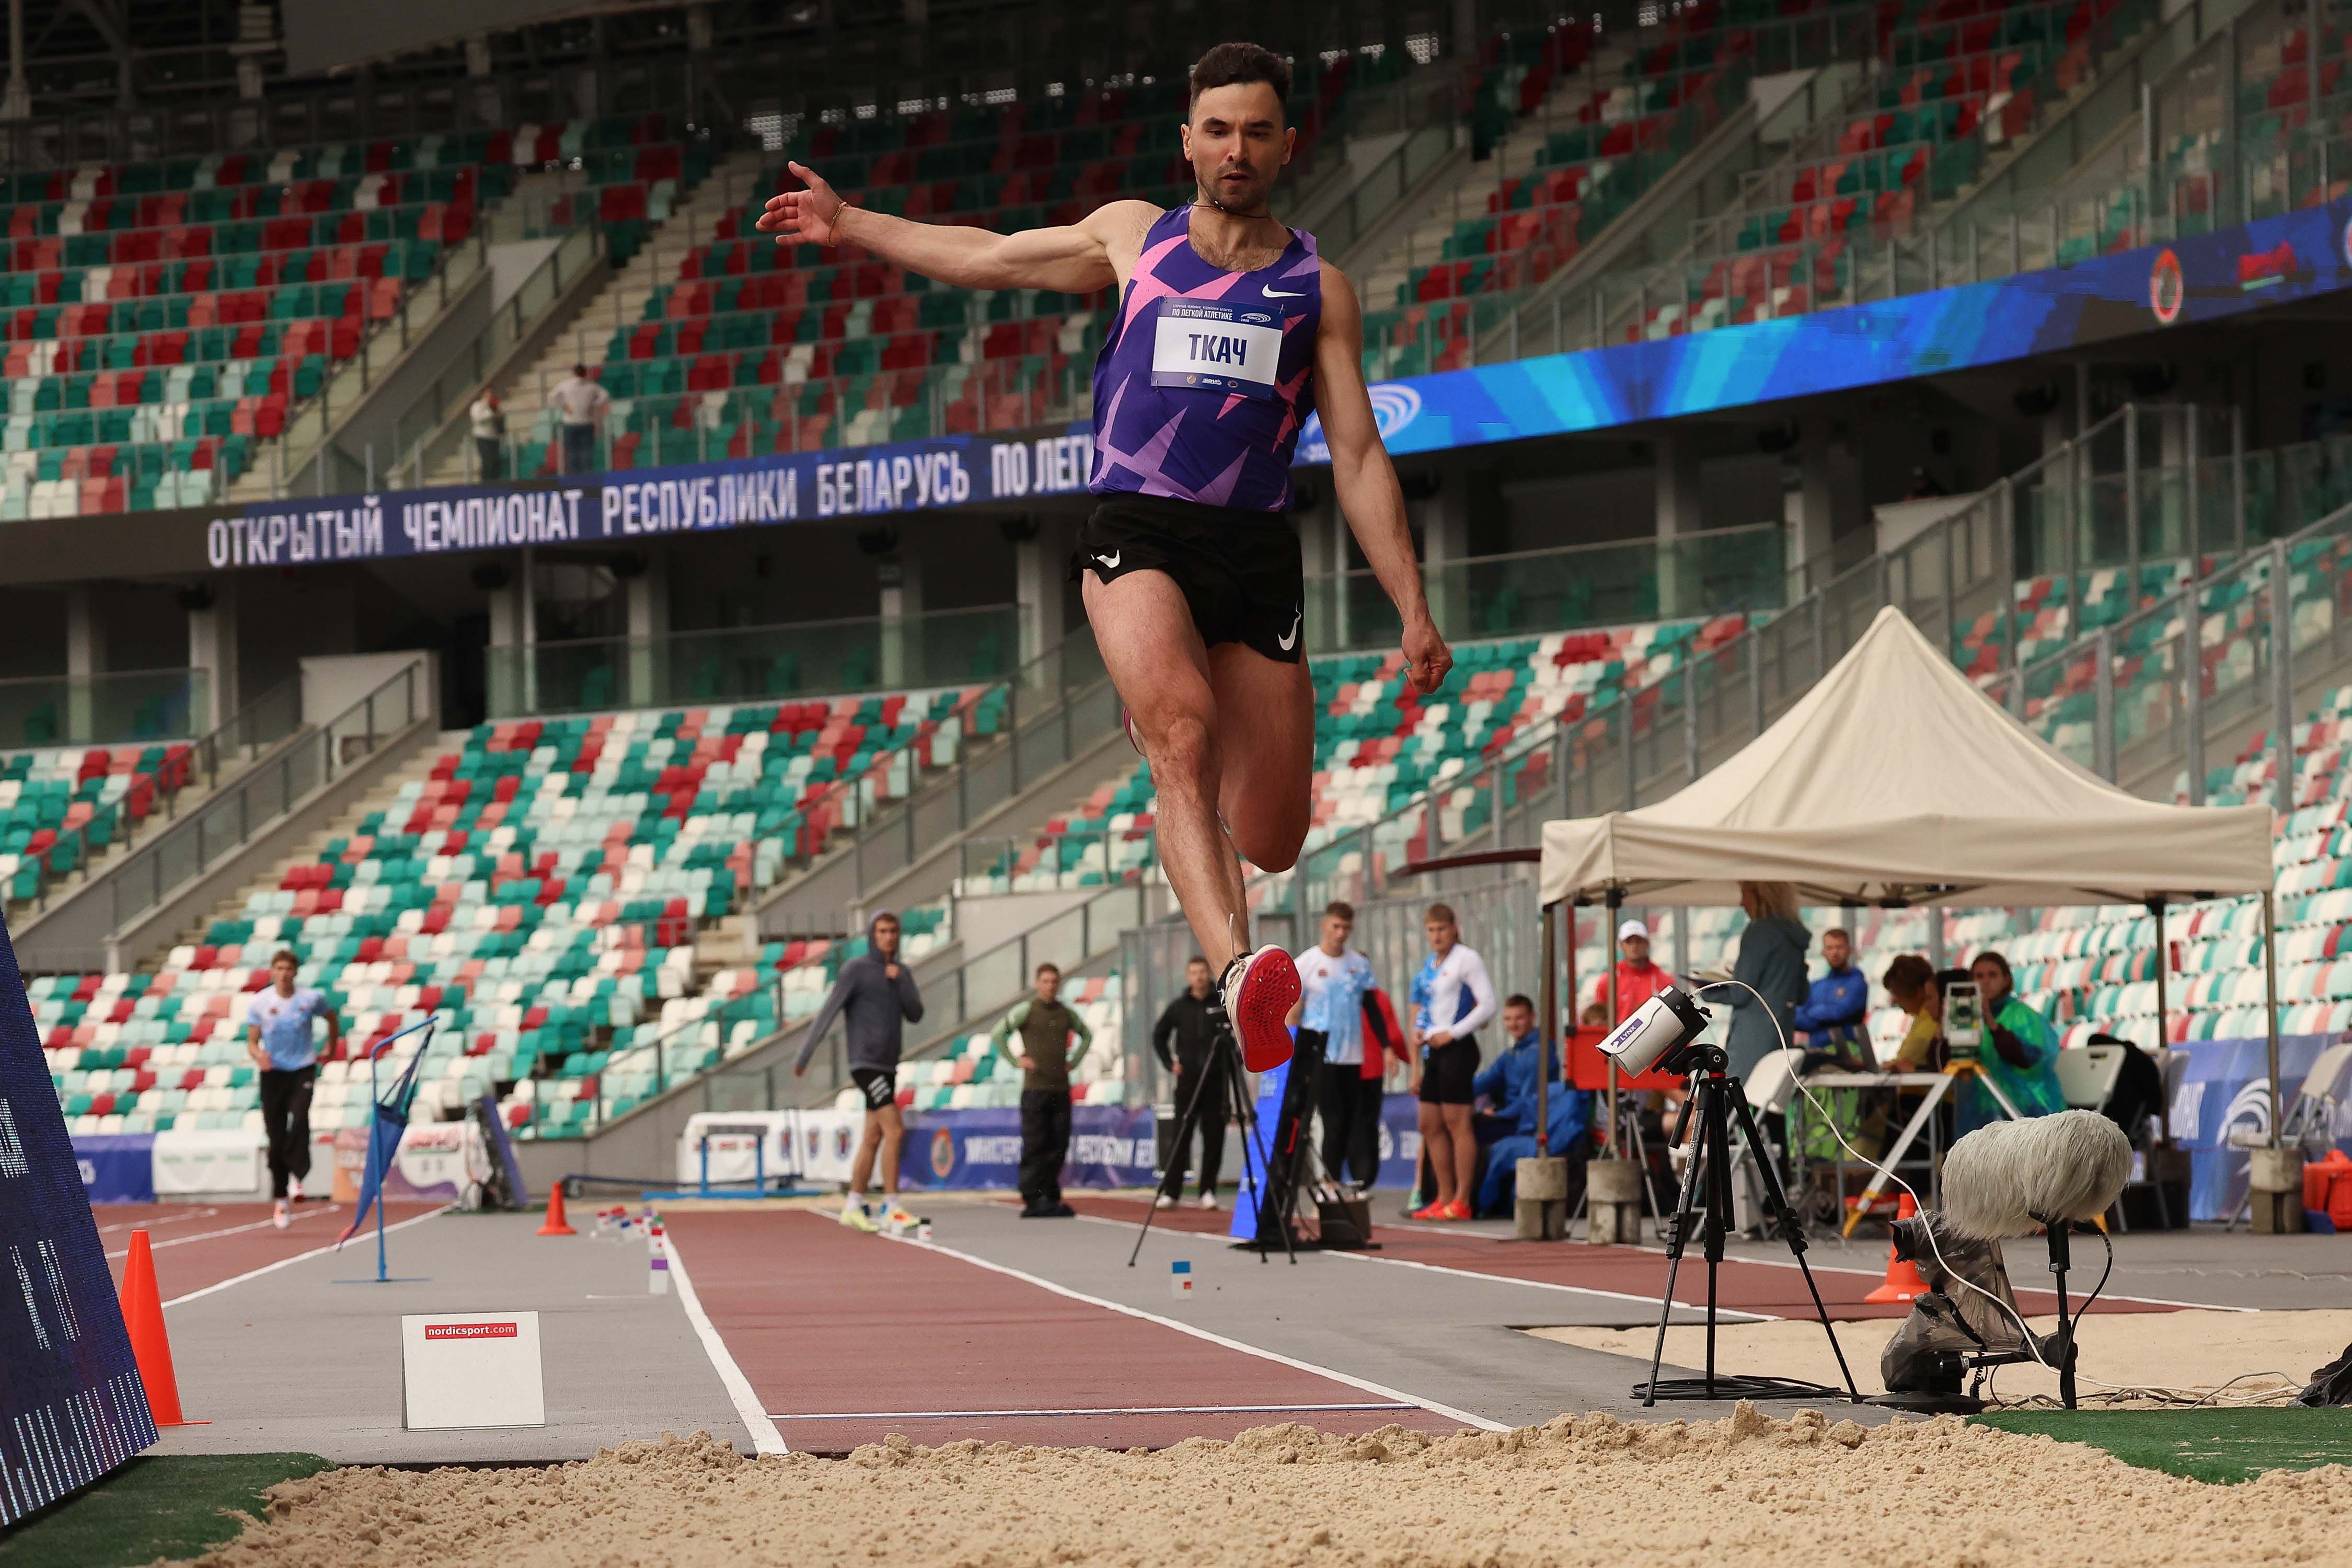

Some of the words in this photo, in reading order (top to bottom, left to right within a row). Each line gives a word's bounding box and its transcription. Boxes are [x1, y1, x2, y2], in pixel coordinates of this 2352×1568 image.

[1181, 309, 1203, 318] ЛЕГКОЙ
[1204, 310, 1233, 320] АТЛЕТИКЕ
[1189, 333, 1247, 366] ТКАЧ
[207, 494, 384, 569] ОТКРЫТЫЙ
[402, 490, 584, 552] ЧЕМПИОНАТ
[601, 467, 798, 536] РЕСПУБЛИКИ
[815, 451, 970, 517] БЕЛАРУСЬ
[990, 441, 1029, 497] ПО
[1620, 1024, 1636, 1041] LYNX
[428, 1325, 514, 1336] nordicsport.com
